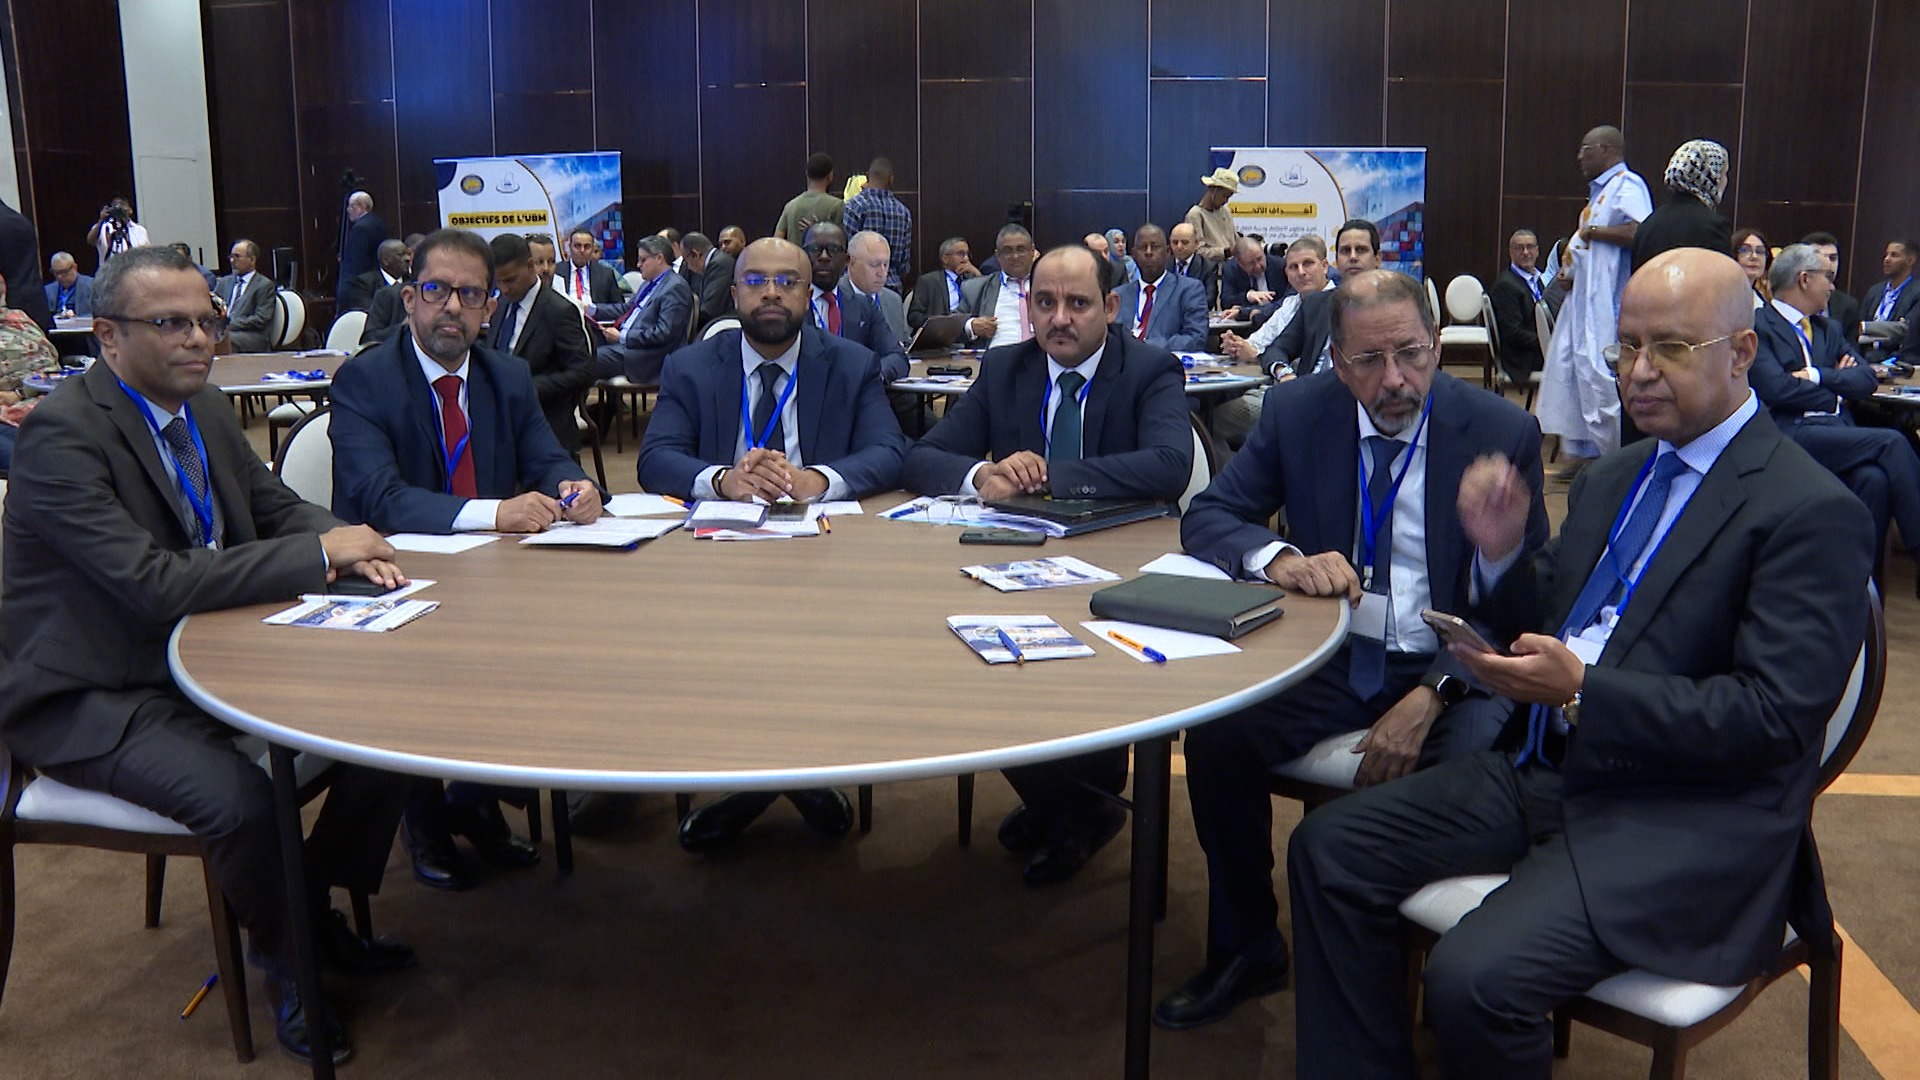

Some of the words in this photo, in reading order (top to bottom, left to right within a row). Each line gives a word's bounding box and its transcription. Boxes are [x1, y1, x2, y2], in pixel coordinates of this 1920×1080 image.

[452, 215, 500, 225] OBJECTIFS
[503, 214, 514, 223] DE
[517, 213, 546, 222] L'UBM
